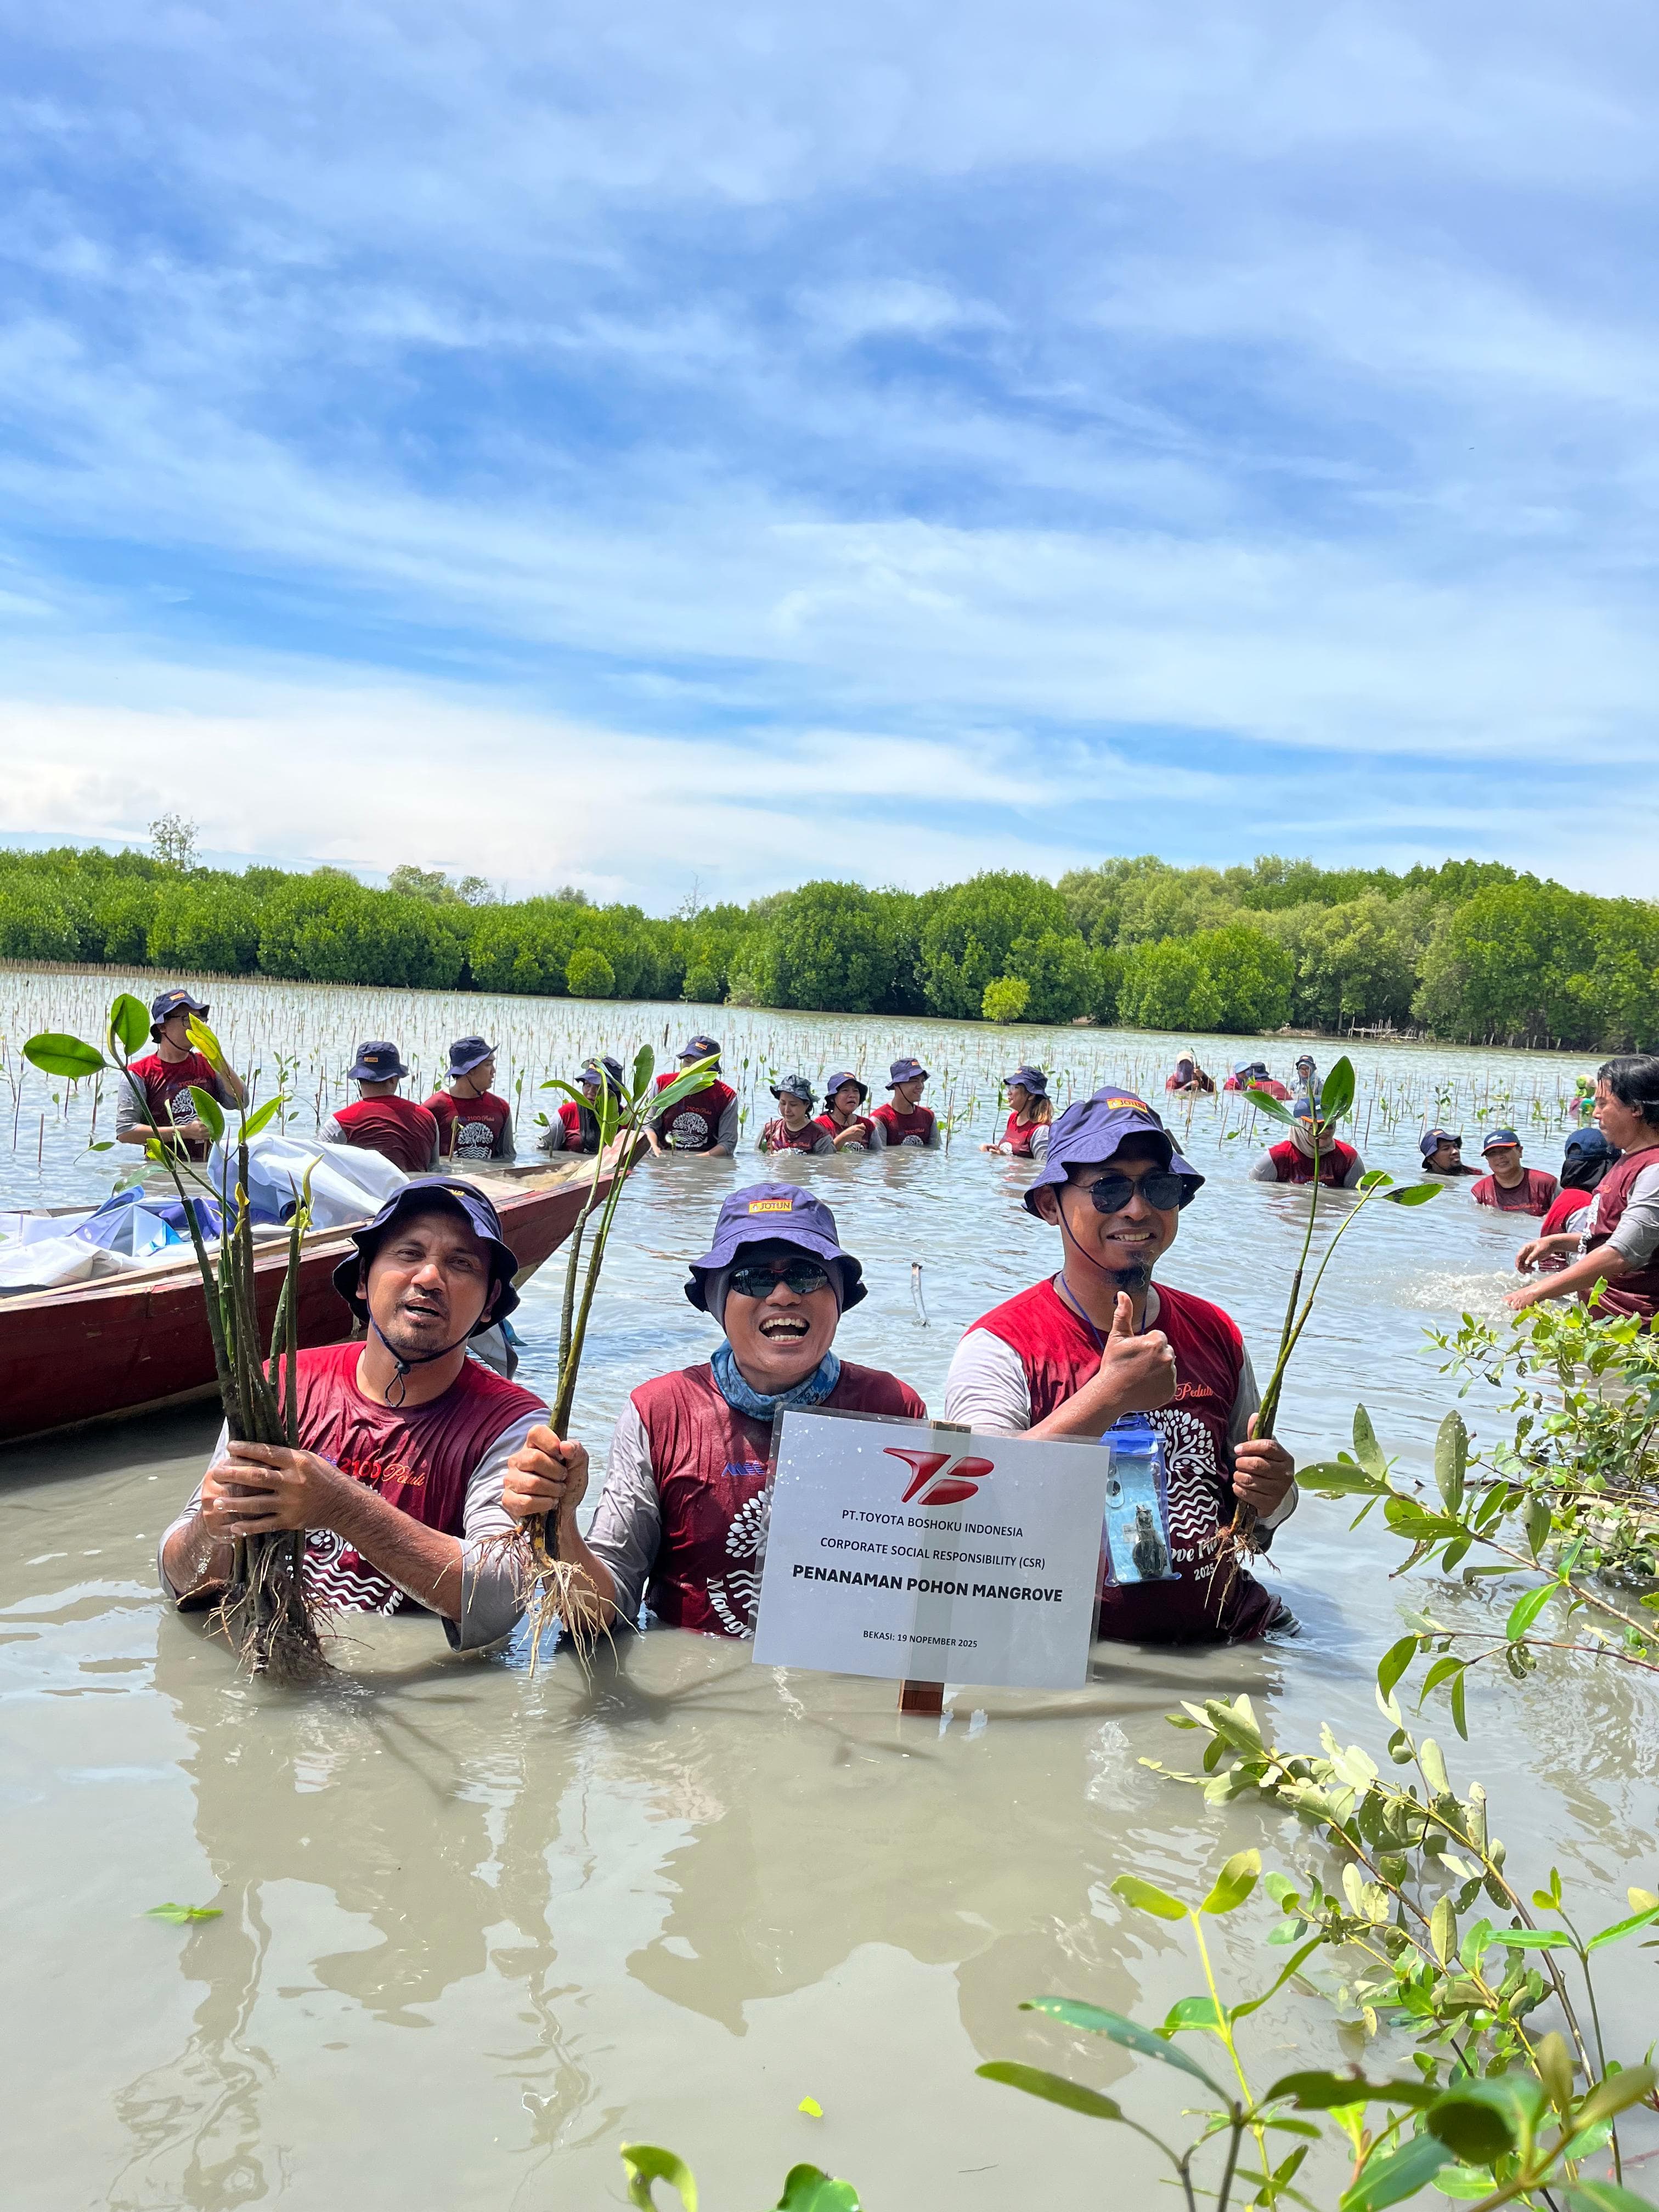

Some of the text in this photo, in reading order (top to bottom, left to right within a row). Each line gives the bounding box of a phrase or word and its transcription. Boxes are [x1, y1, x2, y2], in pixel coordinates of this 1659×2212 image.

[842, 1509, 1024, 1537] PT.TOYOTA BOSHOKU INDONESIA
[820, 1537, 1045, 1570] CORPORATE SOCIAL RESPONSIBILITY (CSR)
[792, 1564, 1063, 1602] PENANAMAN POHON MANGROVE
[1194, 1562, 1215, 1581] 2025
[863, 1630, 978, 1648] BEKASI: 19 NOPEMBER 2025
